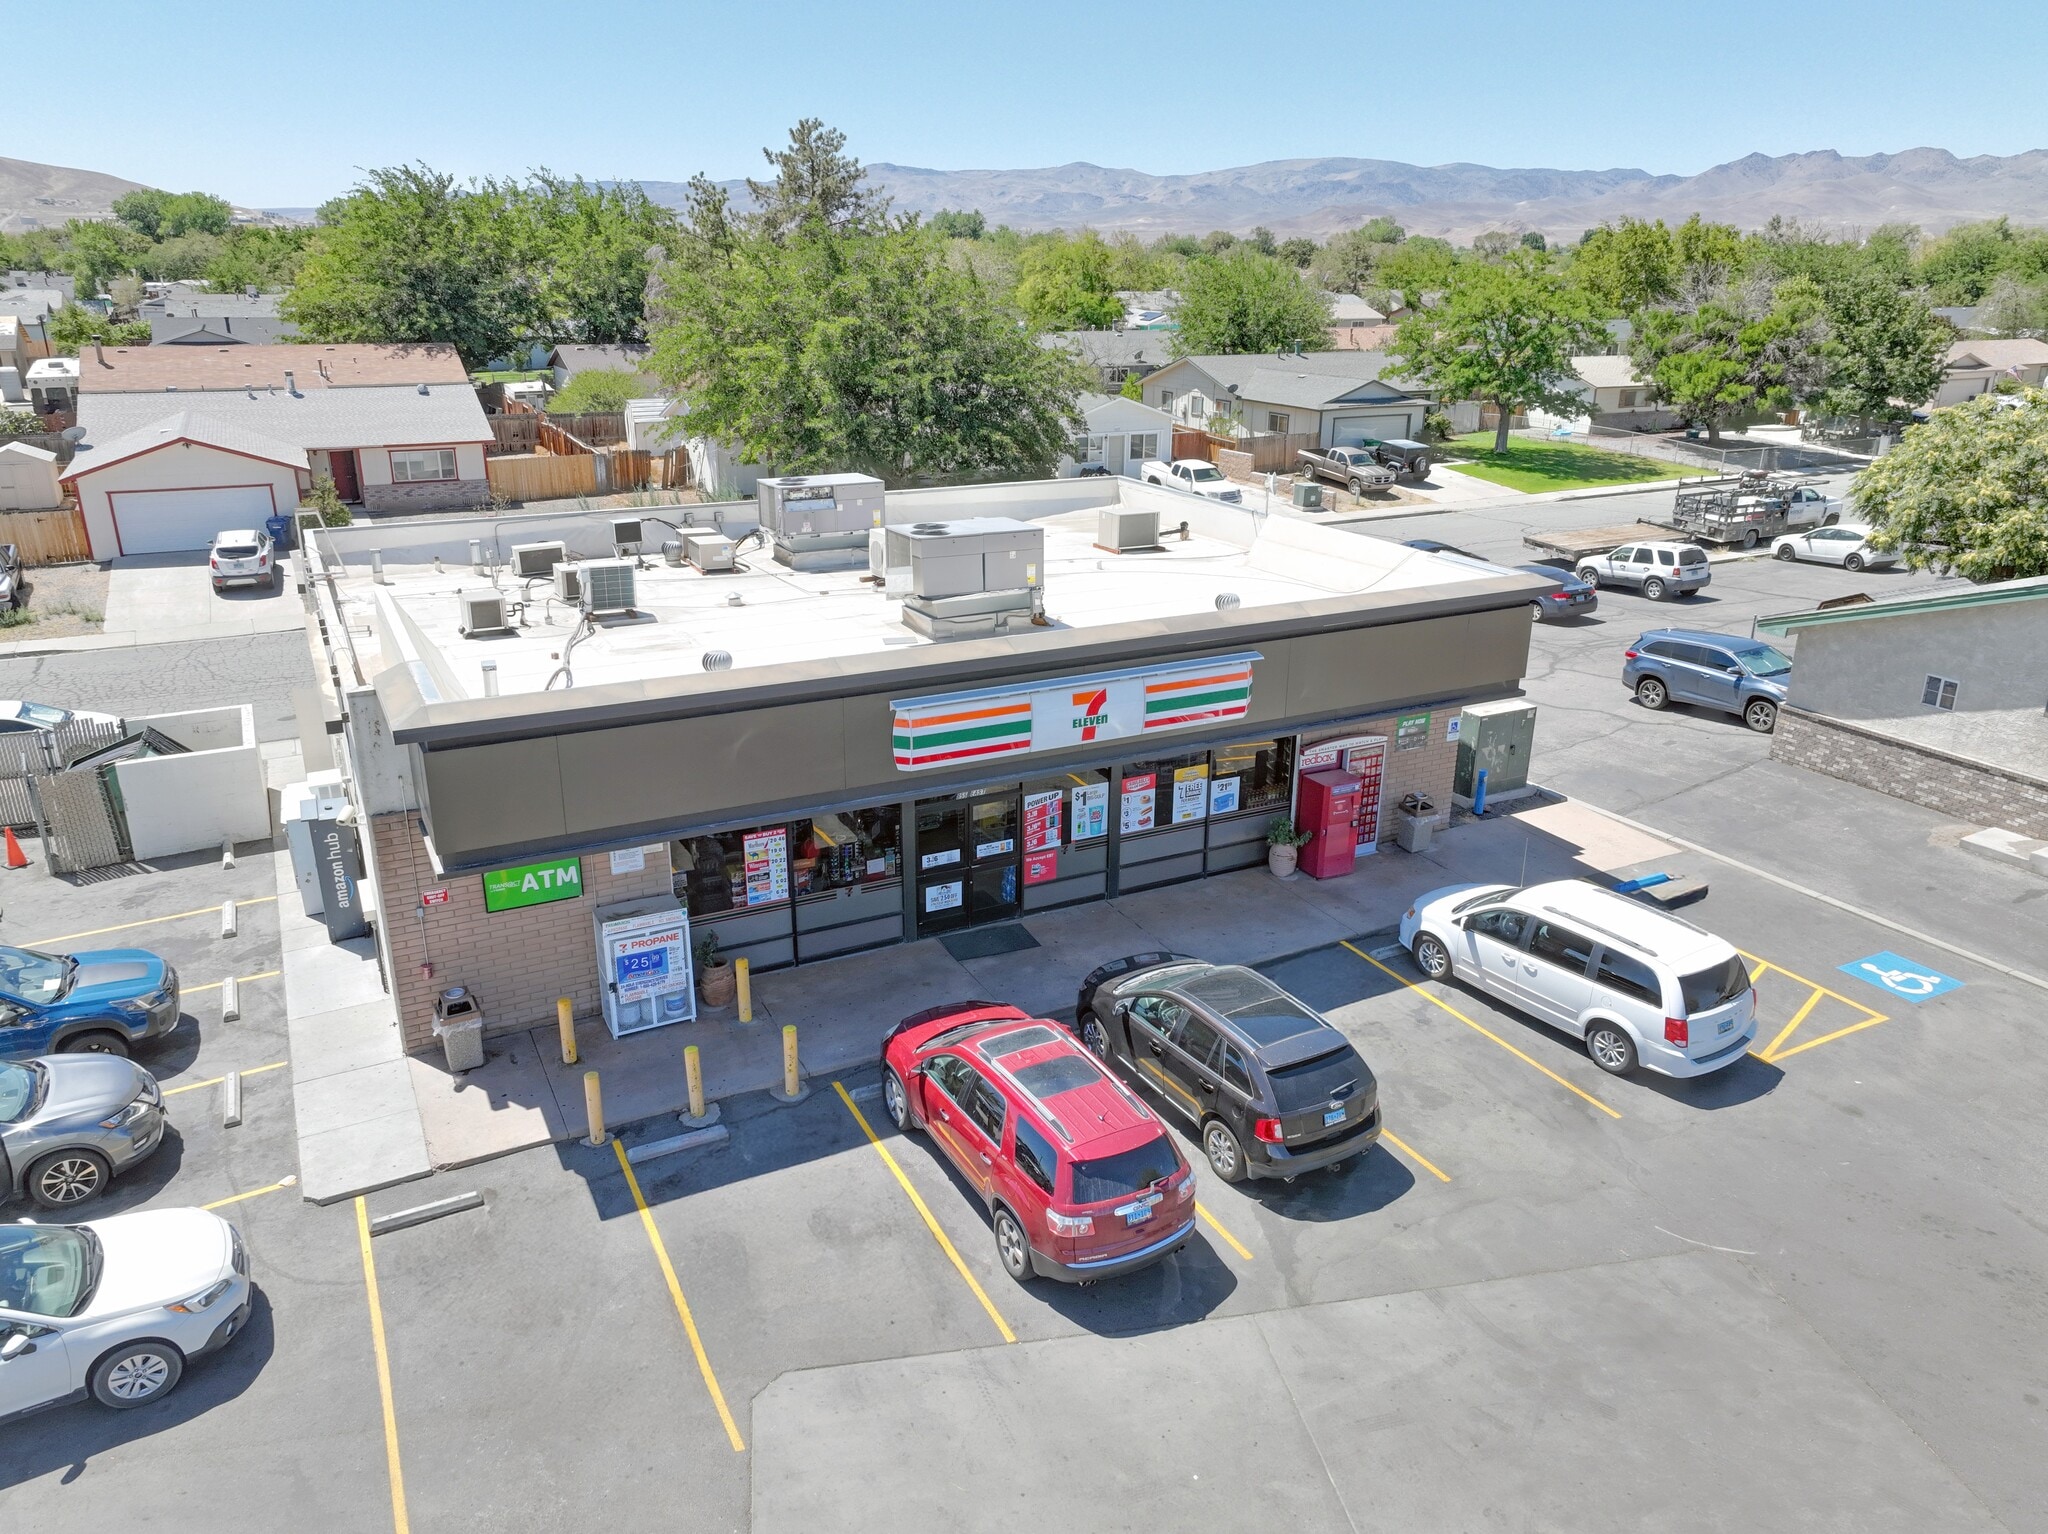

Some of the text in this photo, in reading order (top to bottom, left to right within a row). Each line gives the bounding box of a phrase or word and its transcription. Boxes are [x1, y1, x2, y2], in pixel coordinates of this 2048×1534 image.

[1072, 688, 1107, 741] 7
[1027, 792, 1059, 808] POWER UP
[324, 832, 350, 908] amazon hub
[521, 866, 579, 893] ATM
[631, 932, 680, 949] PROPANE
